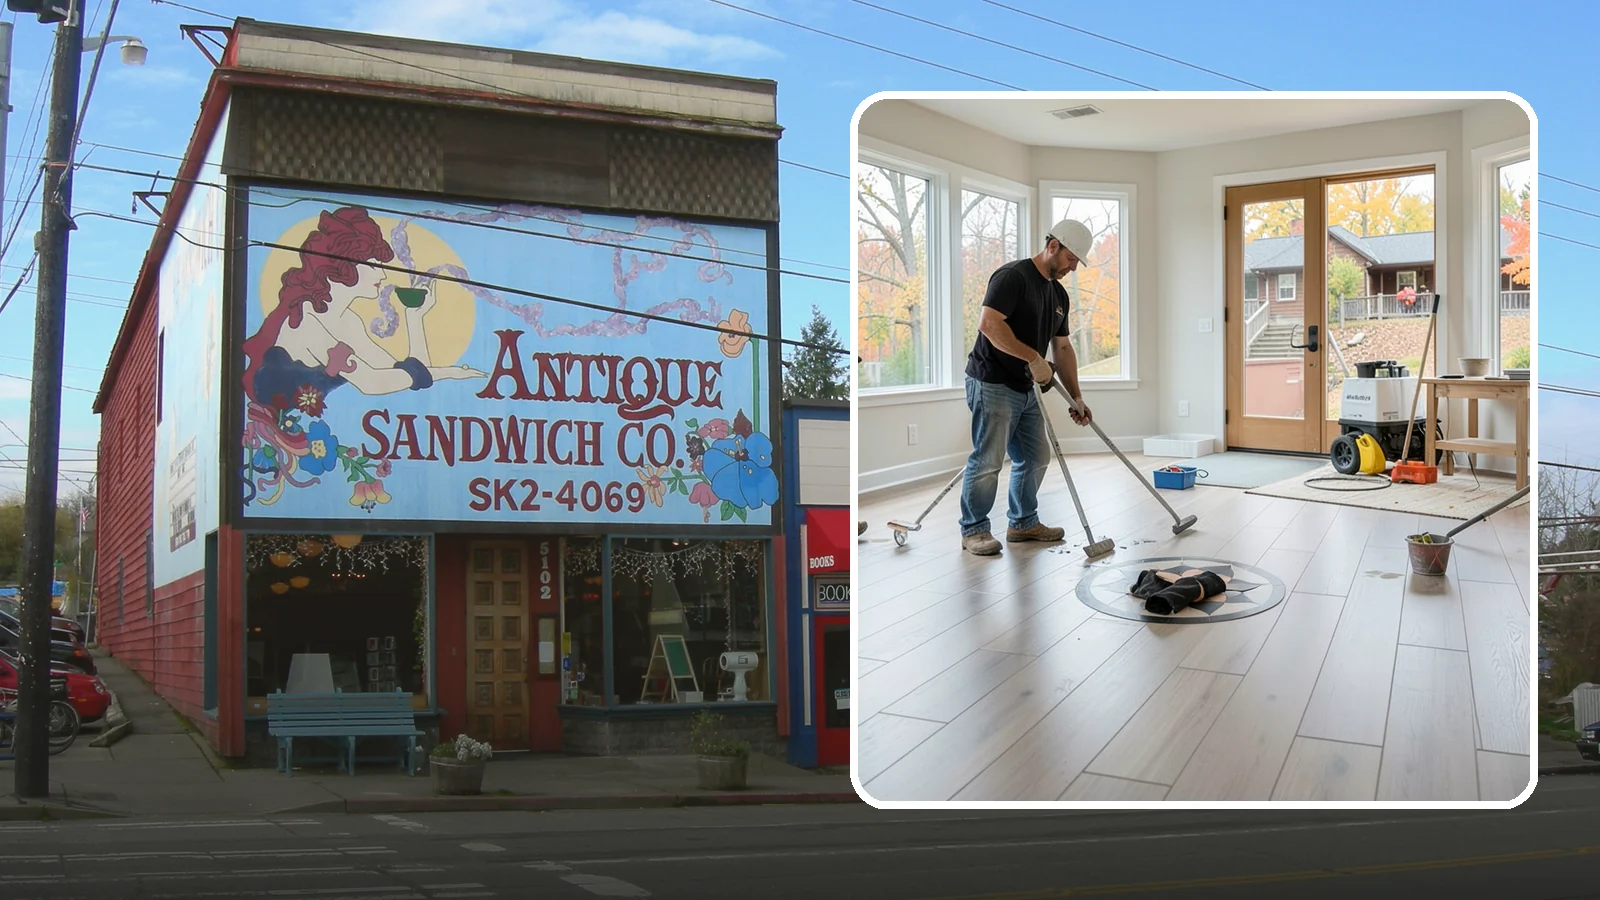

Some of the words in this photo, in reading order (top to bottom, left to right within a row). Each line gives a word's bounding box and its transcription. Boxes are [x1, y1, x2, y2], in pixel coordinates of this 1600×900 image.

[476, 329, 723, 420] ANTIQUE
[361, 409, 604, 468] SANDWICH
[617, 422, 685, 469] CO.
[468, 477, 646, 513] SK2-4069
[540, 541, 551, 600] 5102
[809, 555, 835, 569] BOOKS
